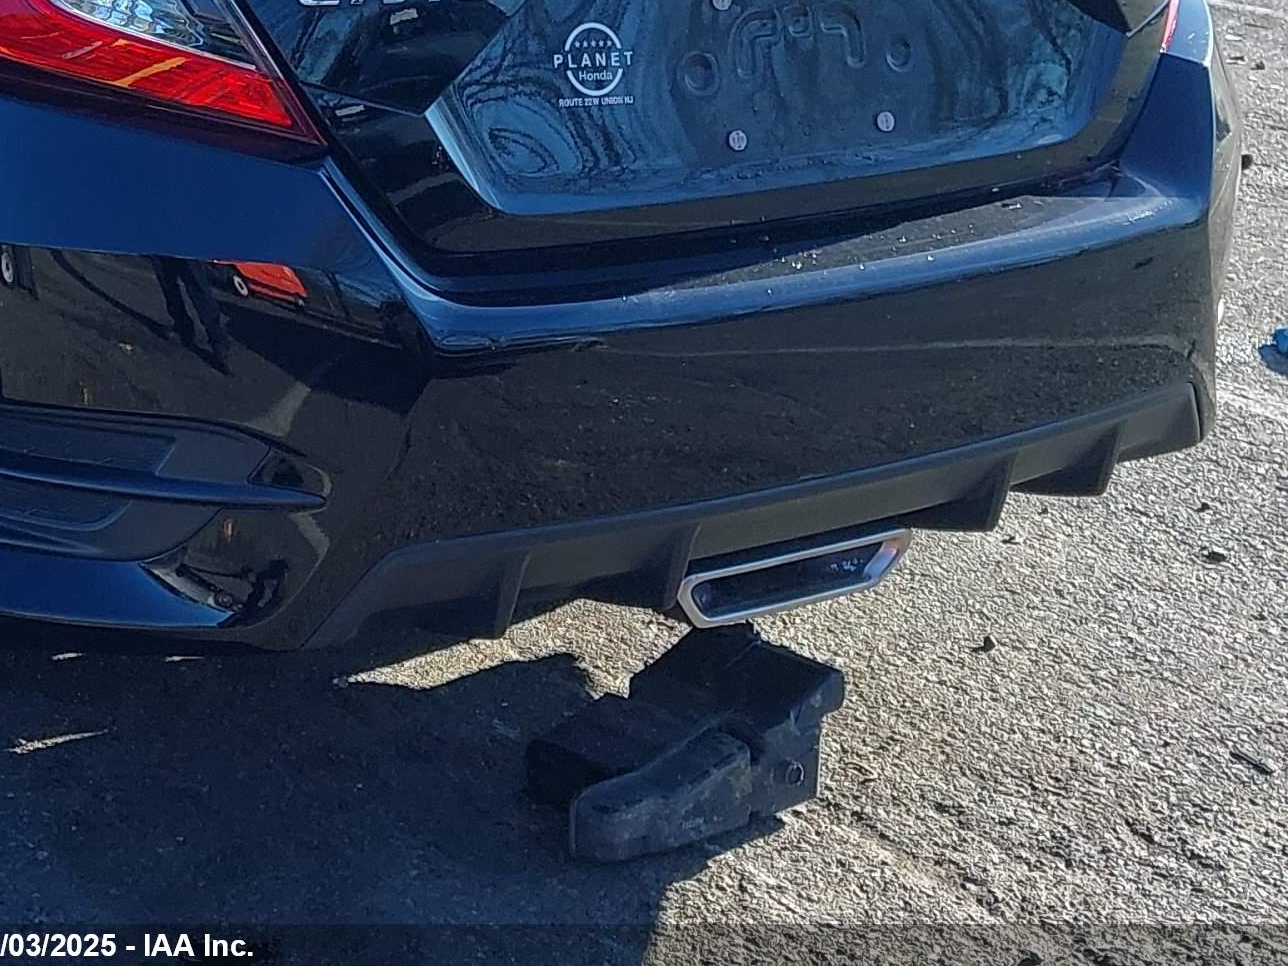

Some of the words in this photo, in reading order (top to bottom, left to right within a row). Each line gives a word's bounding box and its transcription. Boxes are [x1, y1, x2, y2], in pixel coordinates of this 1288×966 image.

[553, 51, 634, 69] PLANET
[578, 69, 613, 82] Honda
[558, 97, 584, 108] ROUTE
